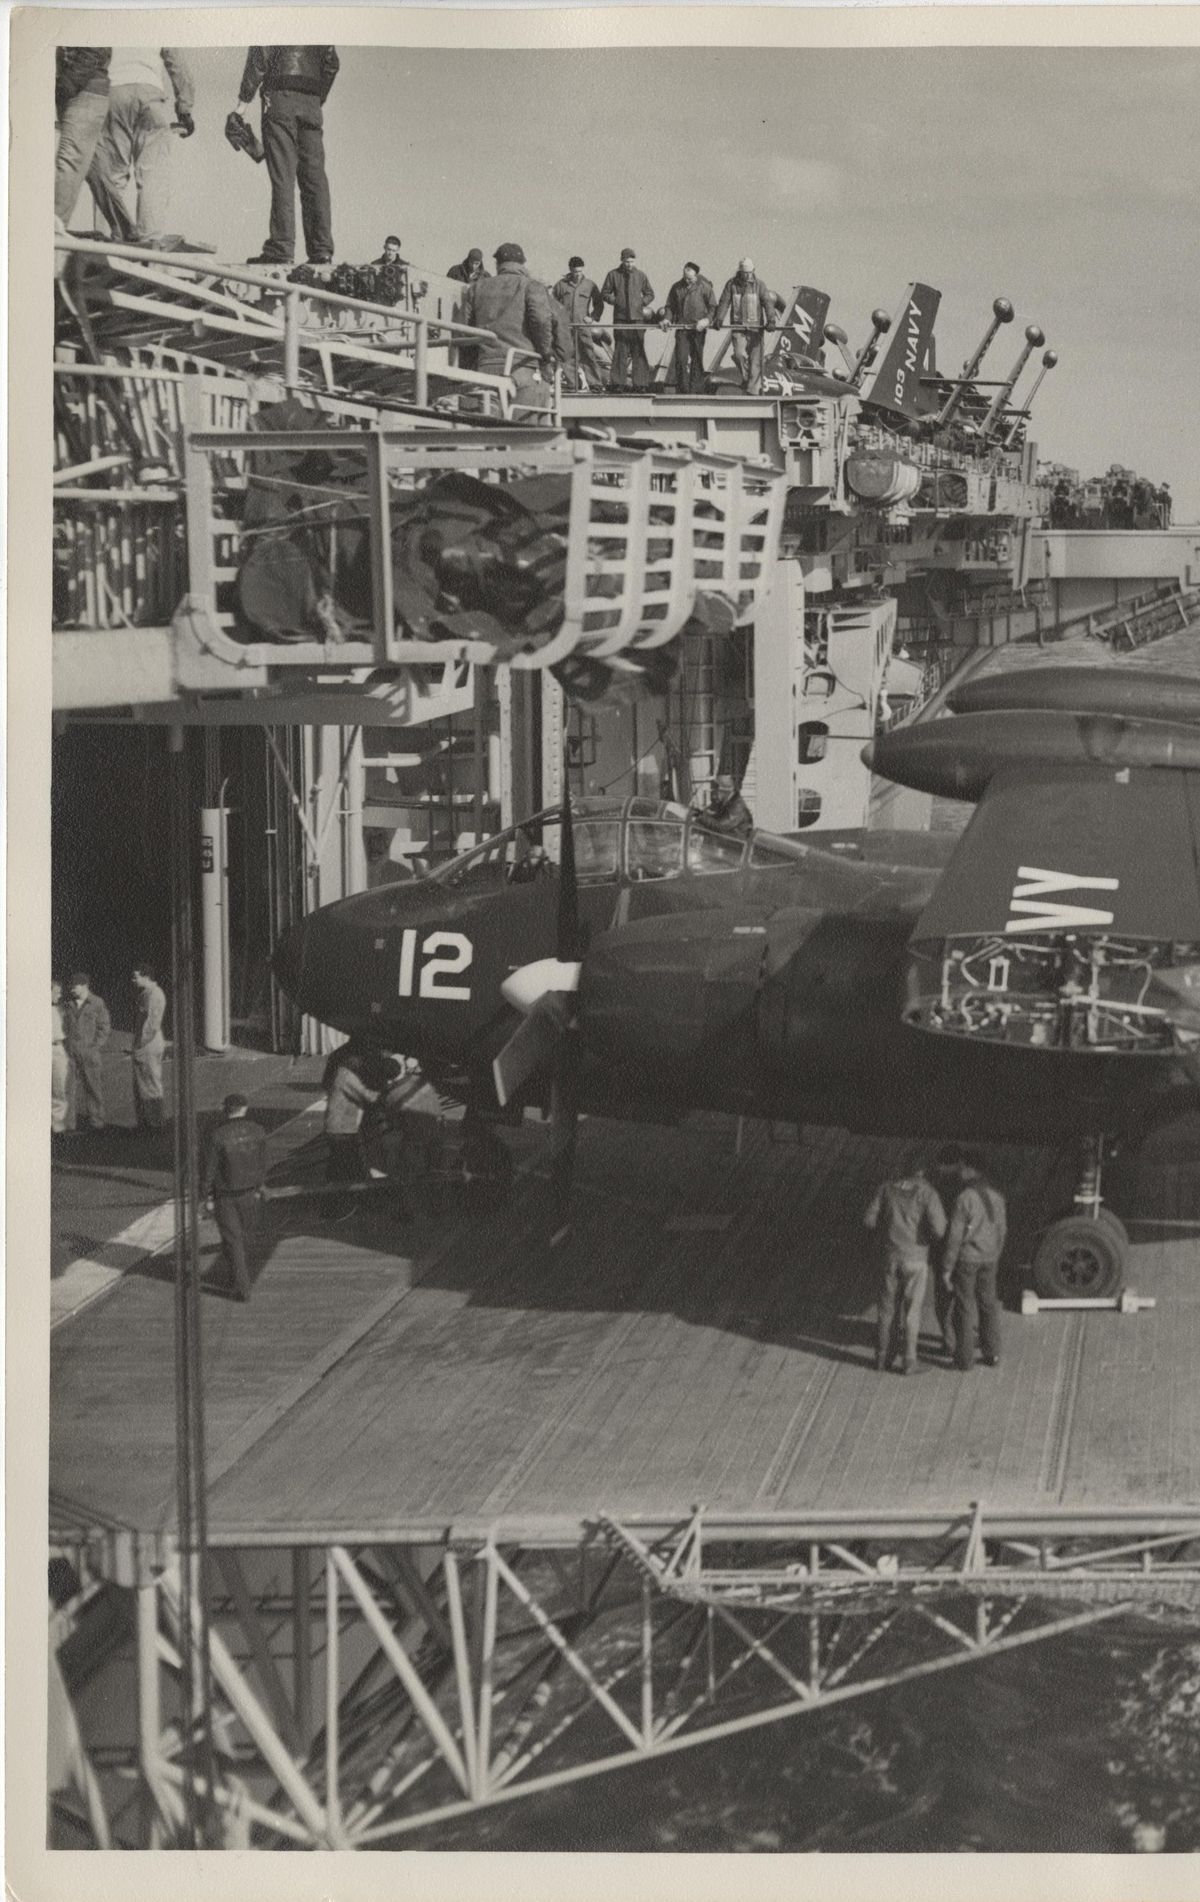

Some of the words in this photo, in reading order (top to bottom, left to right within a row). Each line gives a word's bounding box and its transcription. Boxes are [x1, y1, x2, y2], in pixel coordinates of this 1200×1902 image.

[905, 299, 922, 372] NAVY
[893, 368, 906, 406] 103
[1004, 865, 1120, 933] VY
[398, 929, 474, 1001] 12
